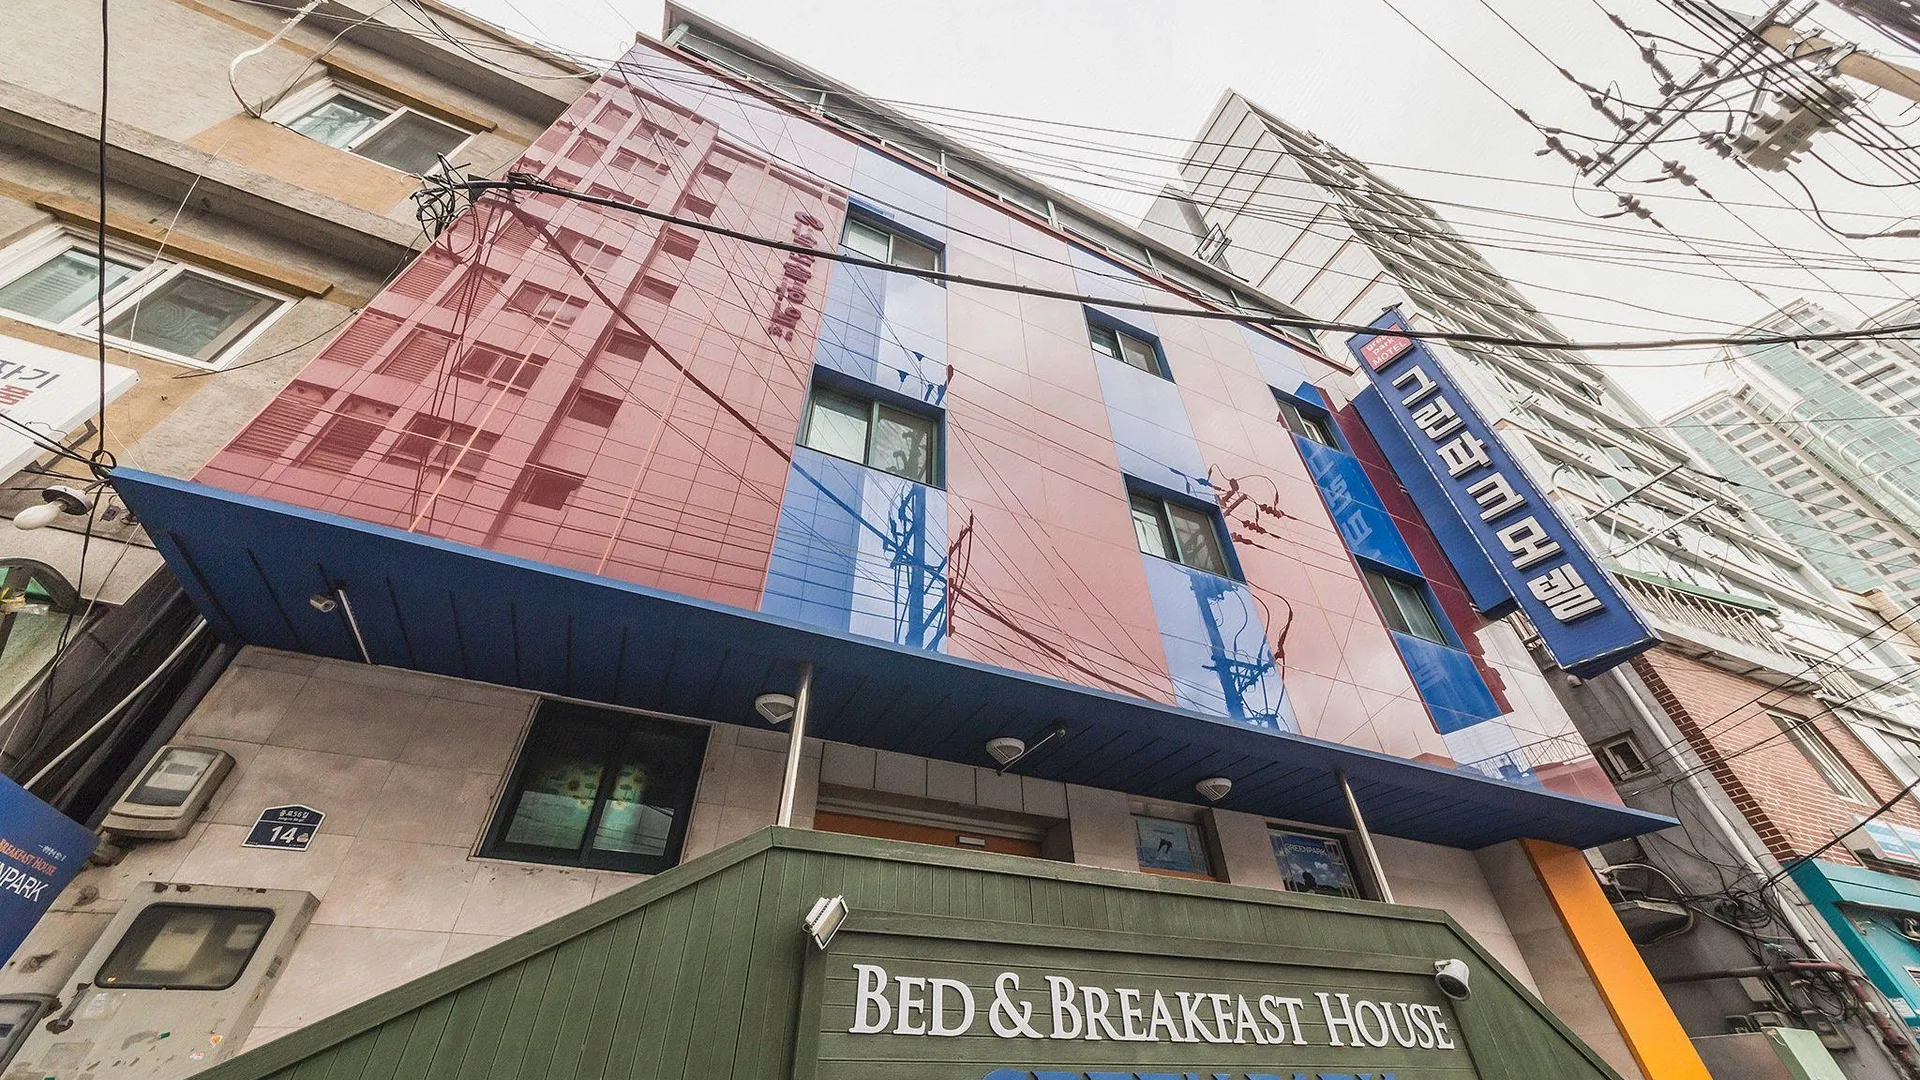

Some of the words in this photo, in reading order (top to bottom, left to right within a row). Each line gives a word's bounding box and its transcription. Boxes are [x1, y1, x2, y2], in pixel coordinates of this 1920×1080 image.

[1373, 341, 1407, 366] MOTEL
[1391, 364, 1605, 624] 그린파크모텔
[270, 825, 298, 844] 14
[849, 964, 975, 1037] BED
[988, 972, 1044, 1039] &
[1044, 975, 1308, 1046] BREAKFAST
[1313, 992, 1455, 1050] HOUSE
